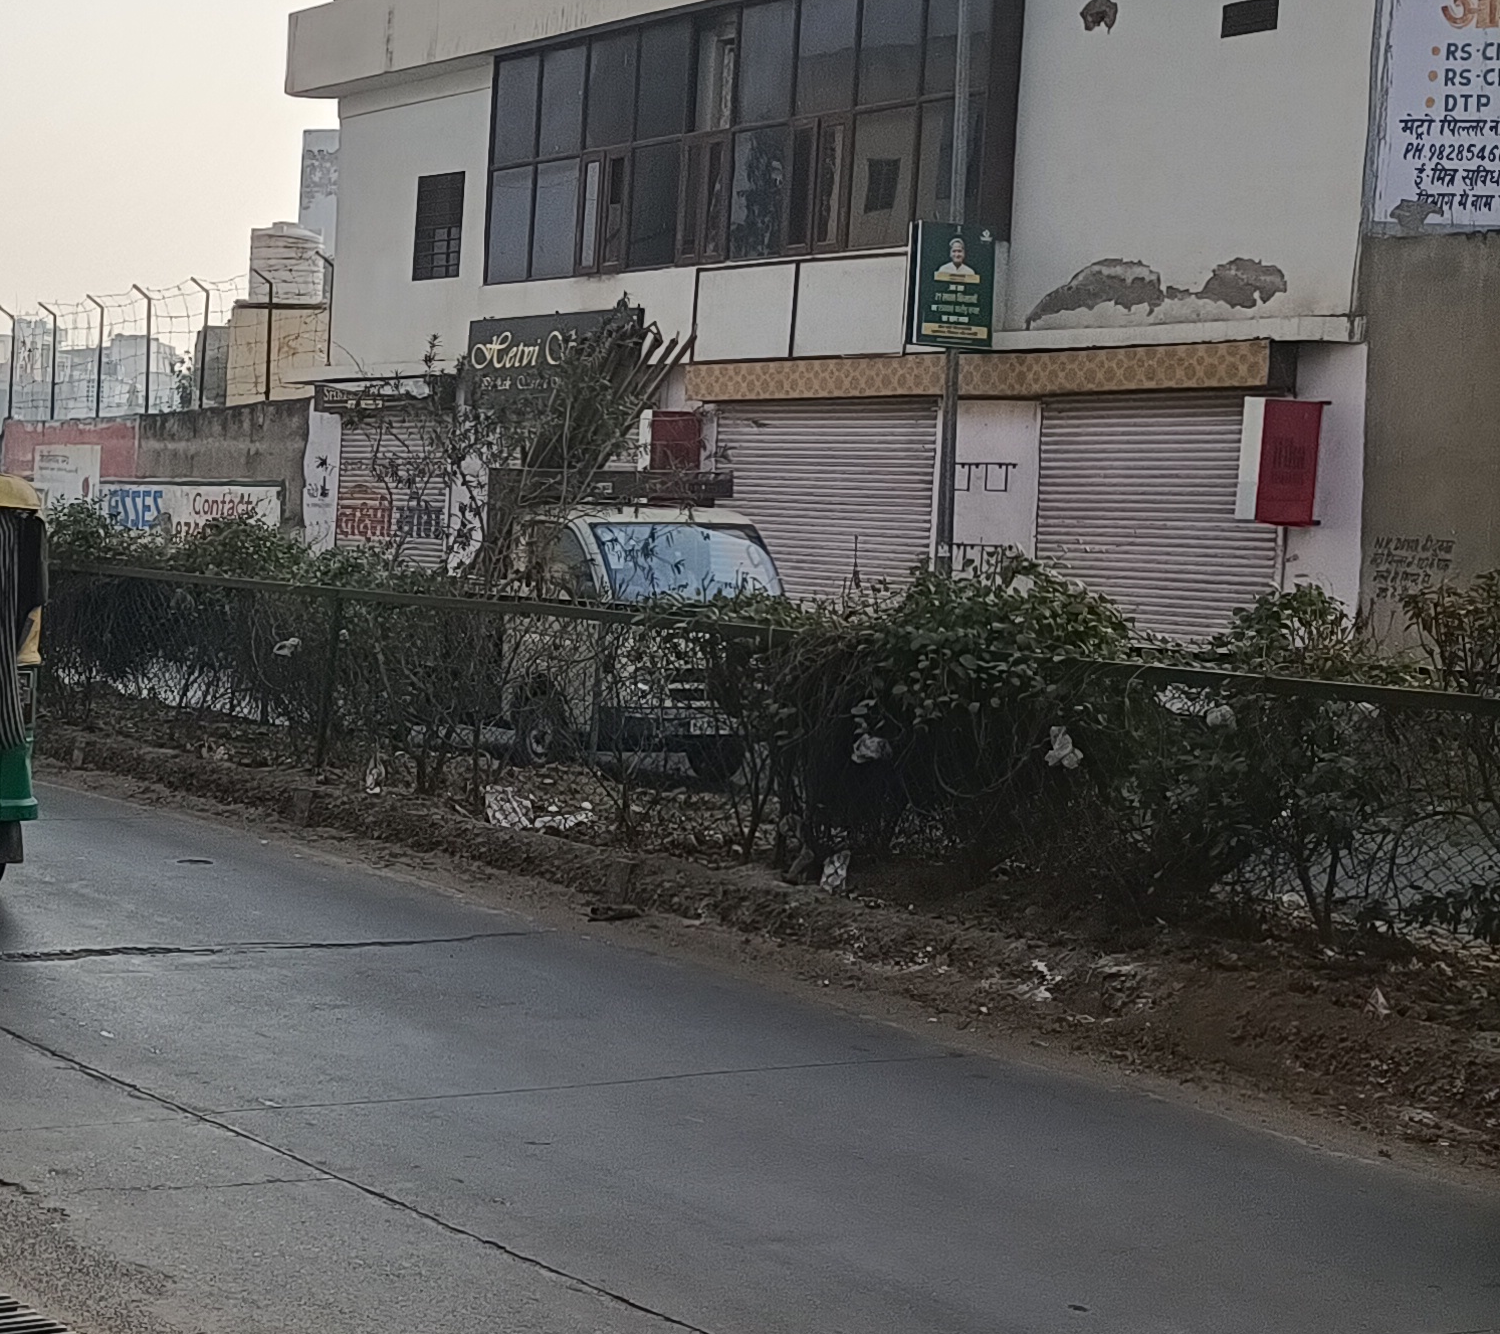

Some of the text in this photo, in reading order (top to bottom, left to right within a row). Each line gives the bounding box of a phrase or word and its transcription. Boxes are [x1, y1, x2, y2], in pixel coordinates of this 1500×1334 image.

[1444, 94, 1491, 113] DTP
[1399, 113, 1436, 140] मेट्रो
[1439, 114, 1487, 137] पिल्लर
[1403, 142, 1500, 163] PH.9828546
[1471, 195, 1495, 213] नाम
[471, 331, 542, 369] Hetvi
